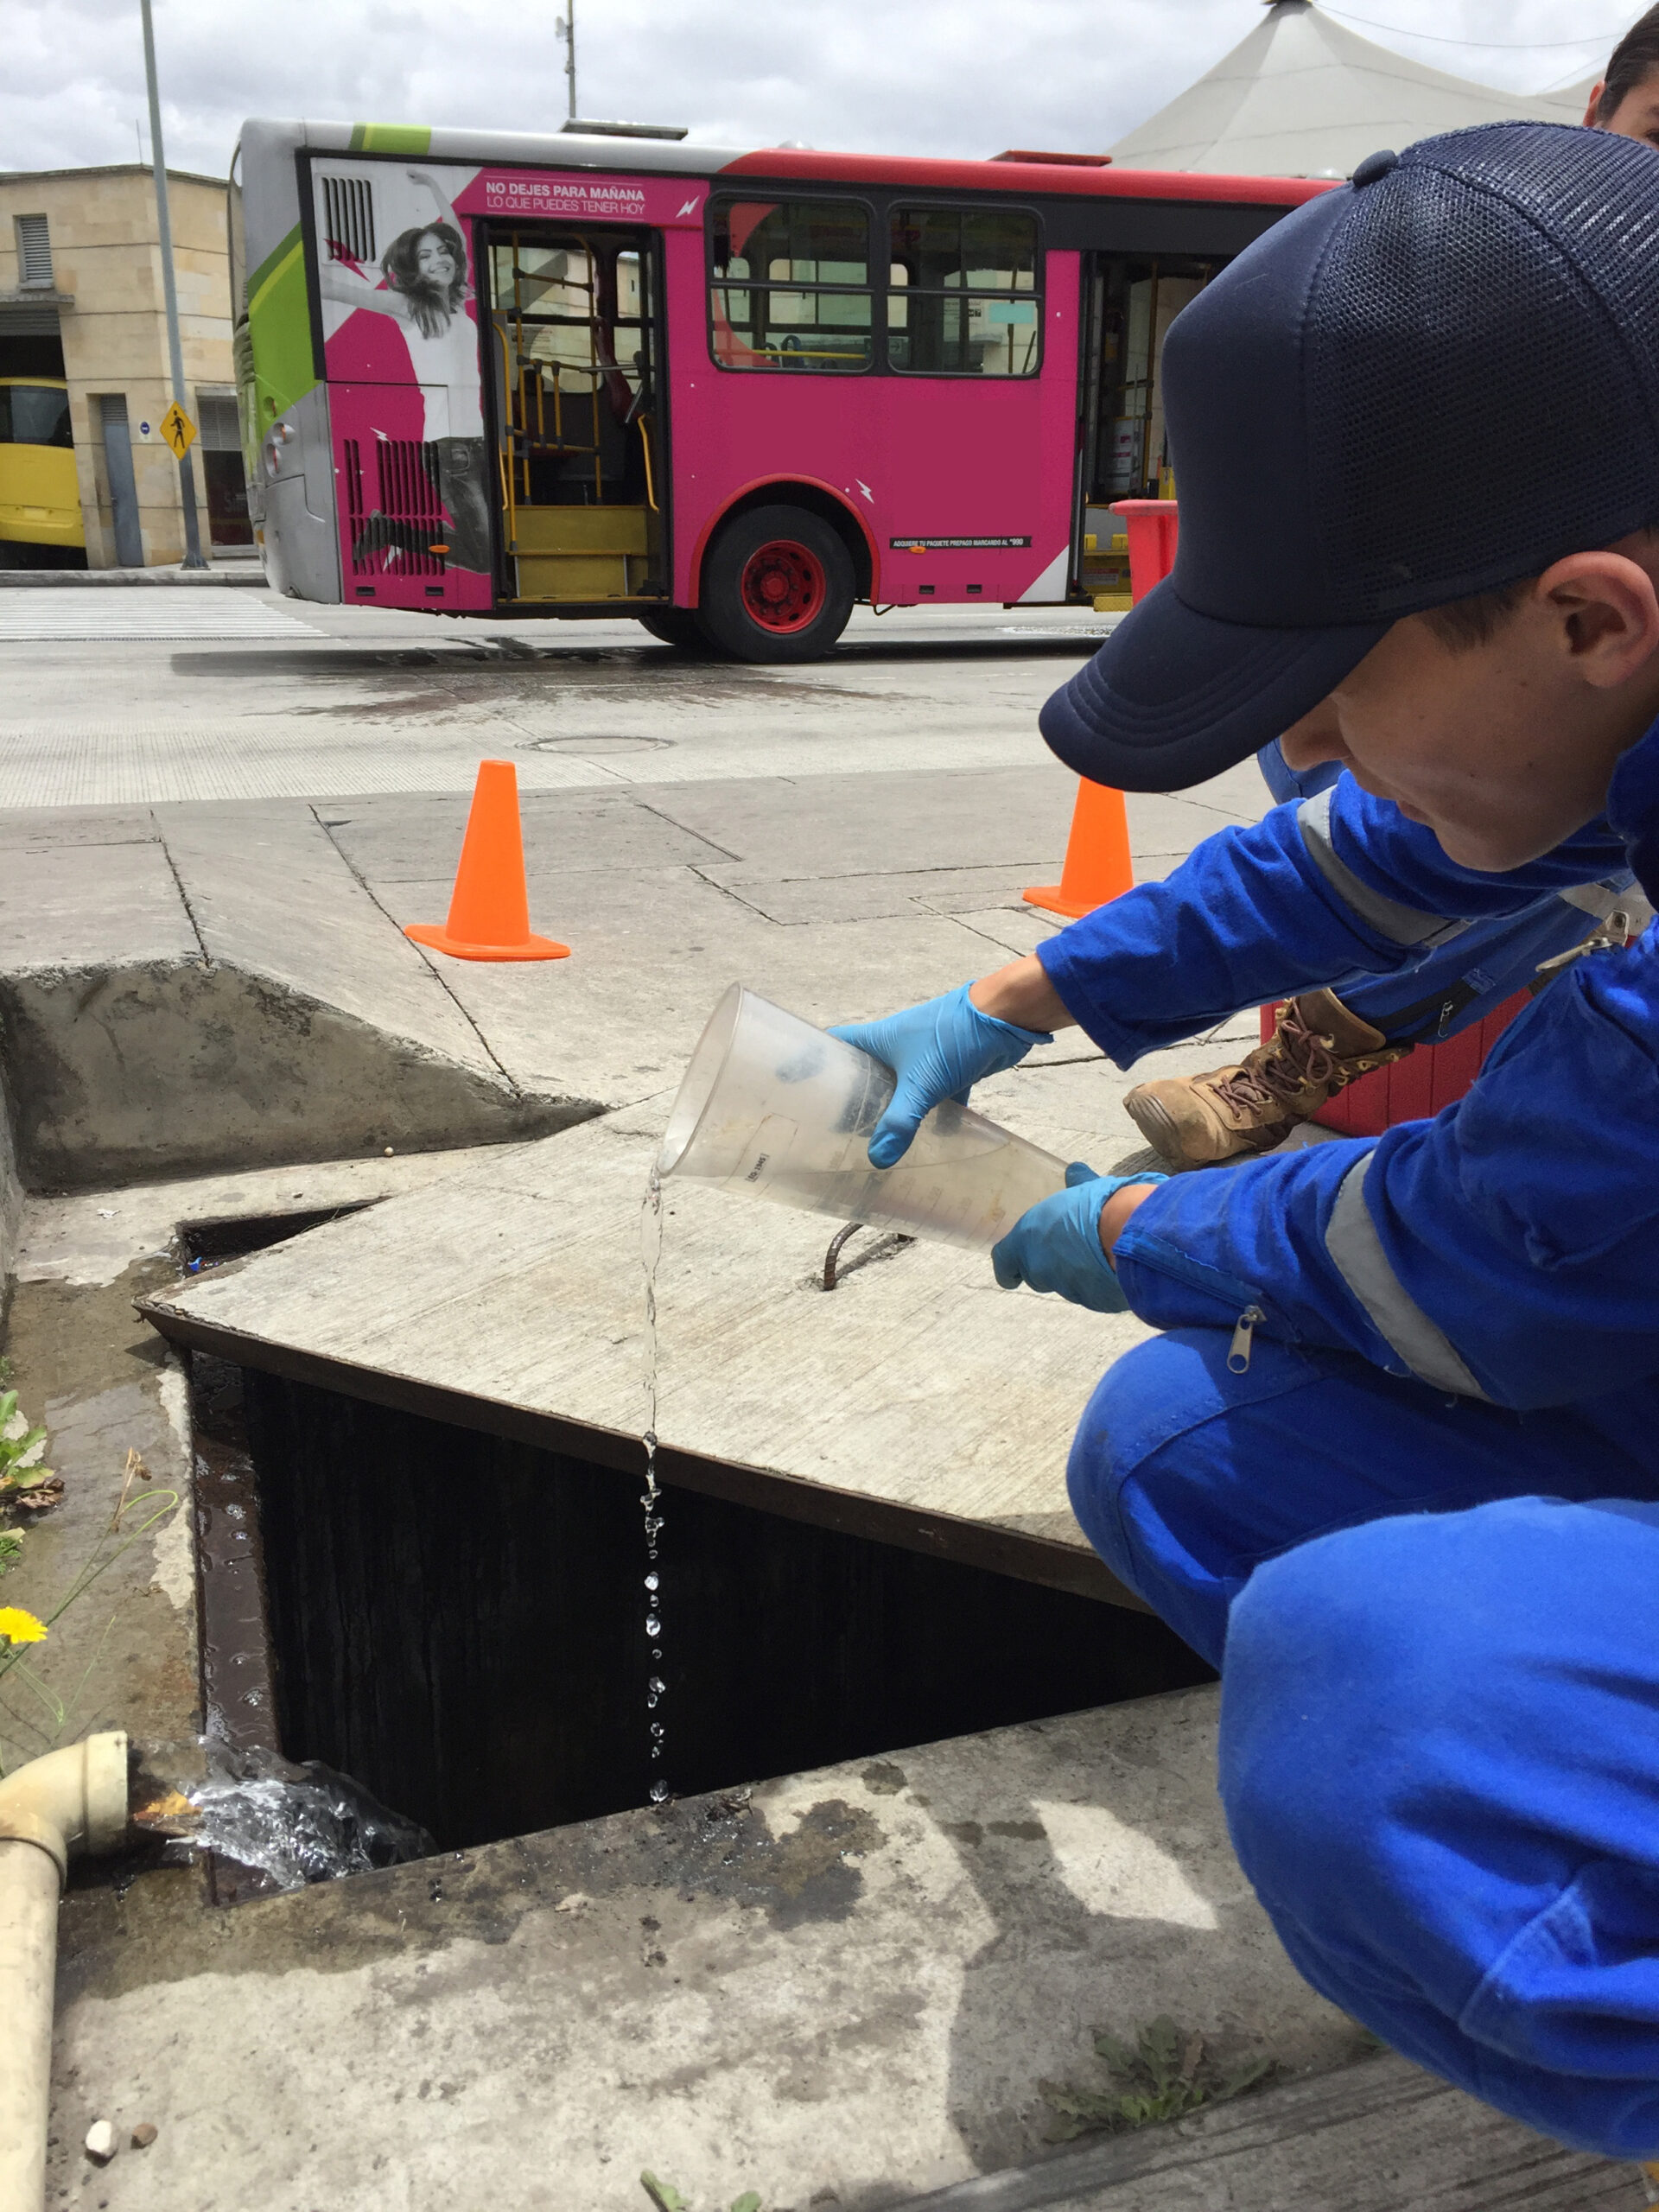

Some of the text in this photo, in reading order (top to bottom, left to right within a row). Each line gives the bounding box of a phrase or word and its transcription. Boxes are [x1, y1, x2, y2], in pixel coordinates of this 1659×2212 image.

[486, 181, 645, 201] NO DEJES PARA MAÑANA
[486, 195, 645, 215] LO QUE PUEDES TENER HOY
